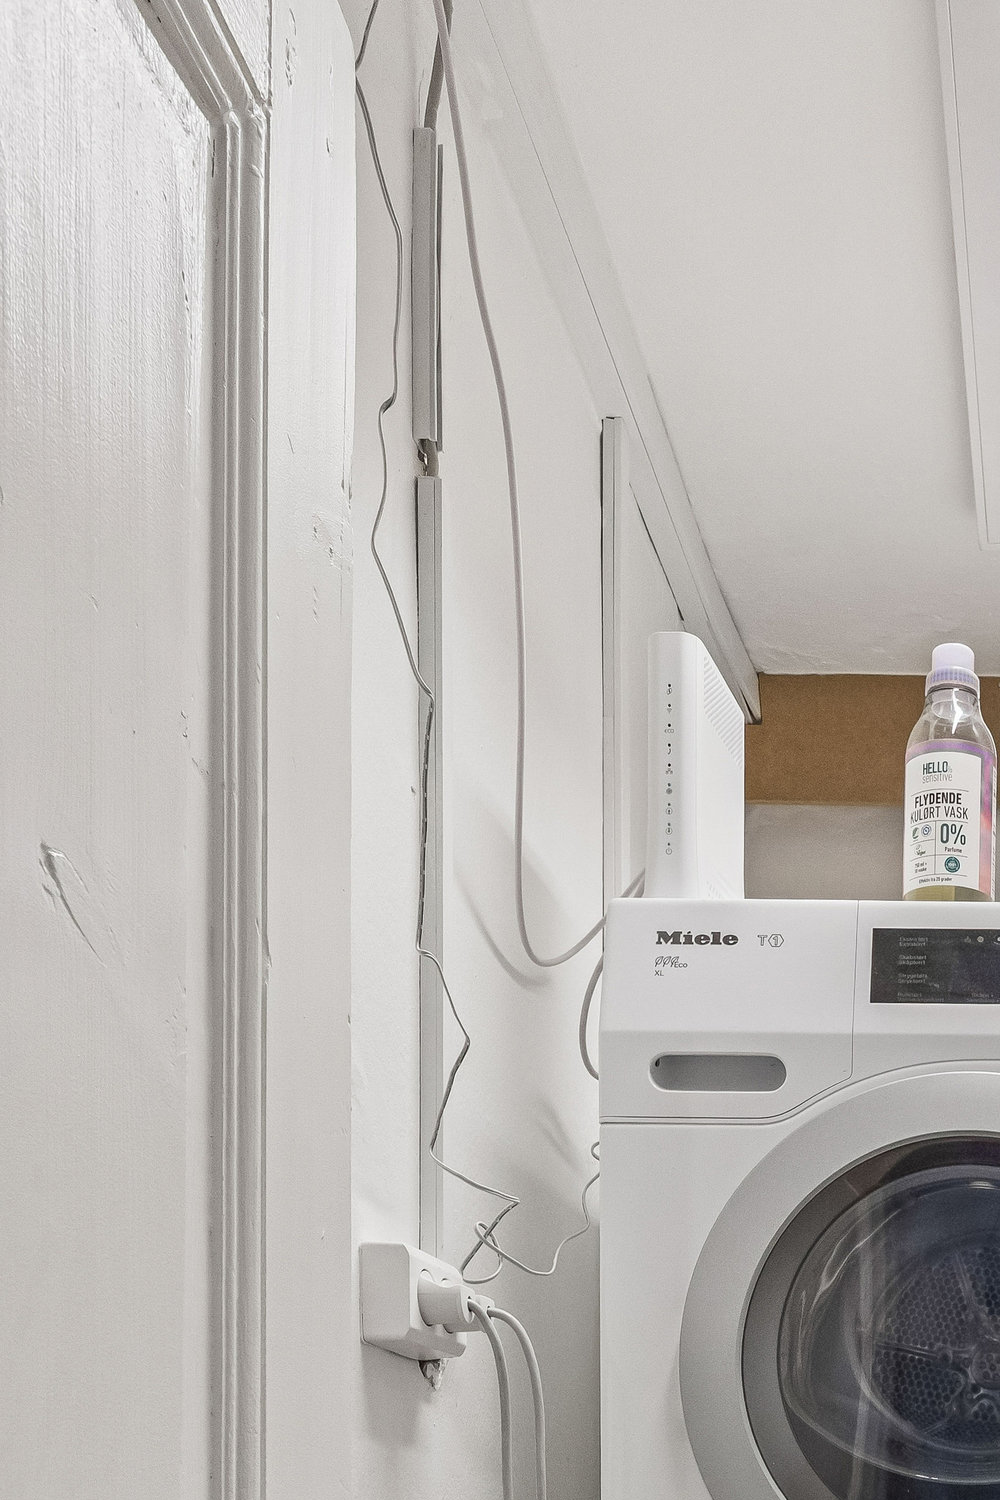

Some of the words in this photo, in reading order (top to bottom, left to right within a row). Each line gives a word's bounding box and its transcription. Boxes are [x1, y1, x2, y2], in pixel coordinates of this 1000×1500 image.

[922, 760, 949, 775] HELLO
[922, 773, 953, 784] sensitive
[914, 792, 962, 809] FLYDENDE
[910, 805, 941, 824] KULØRT
[944, 806, 969, 820] VASK
[940, 823, 966, 846] 0%
[655, 930, 739, 946] Miele
[654, 969, 665, 977] XL
